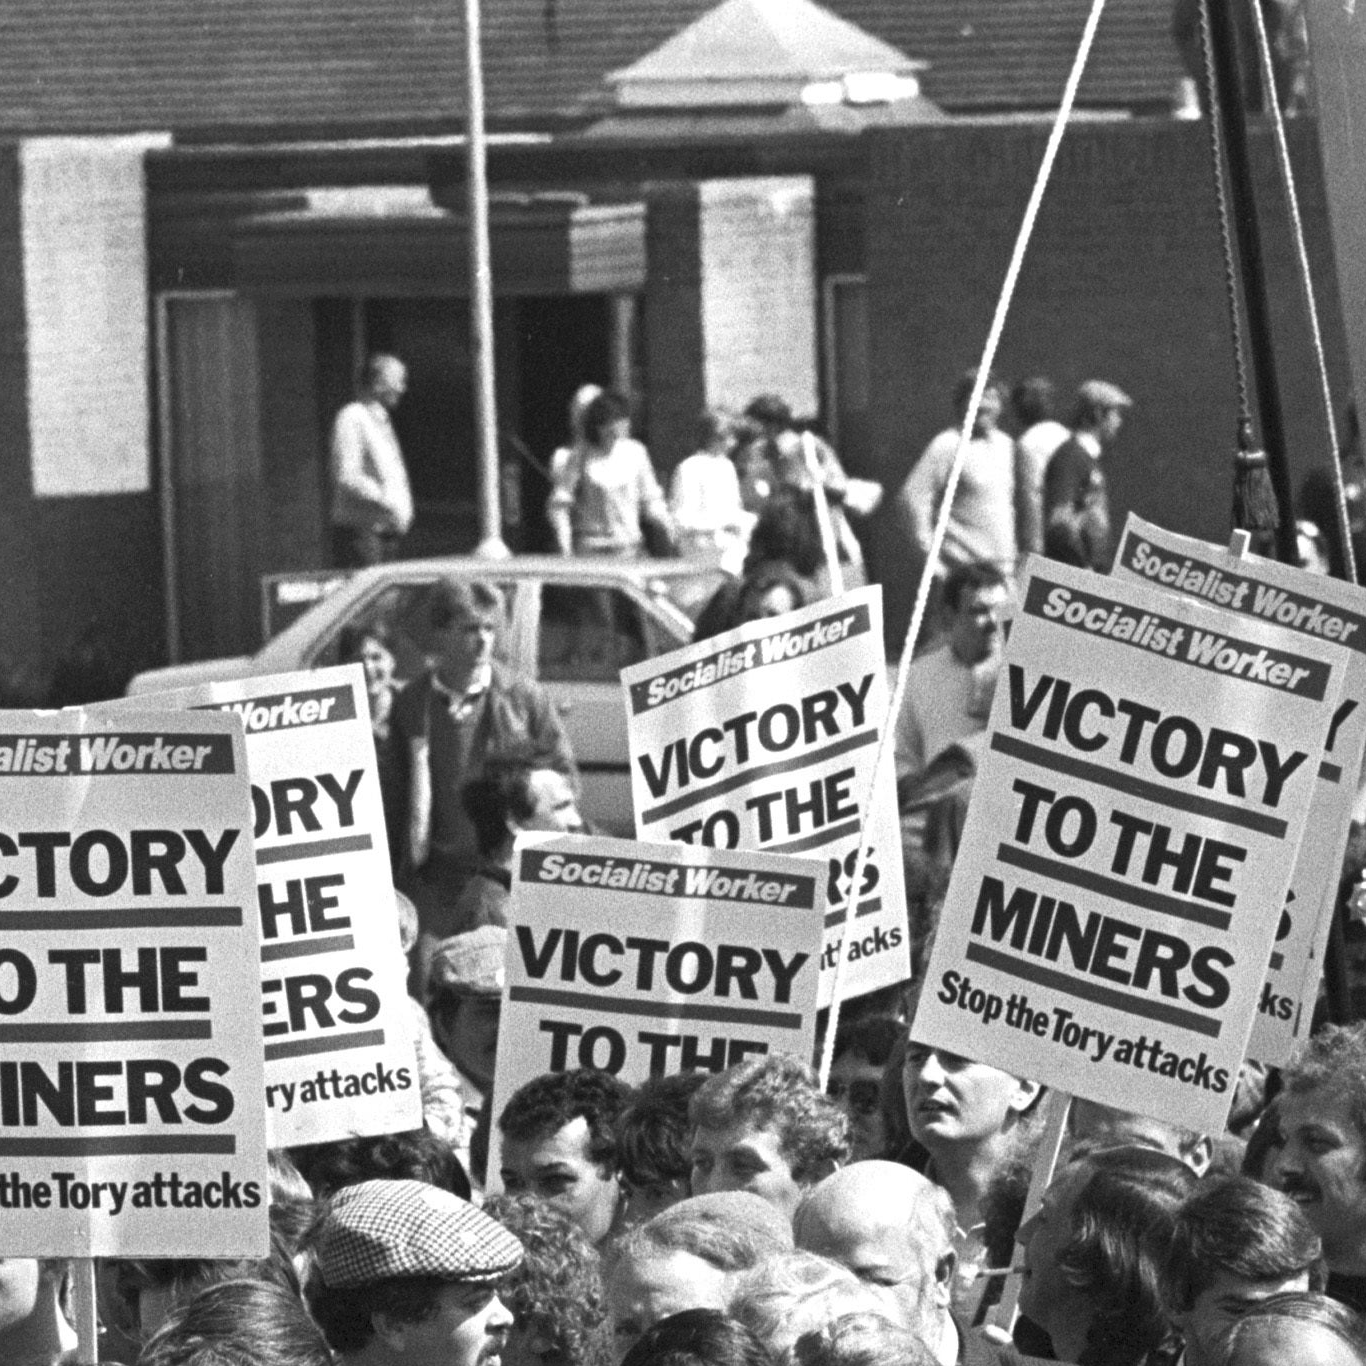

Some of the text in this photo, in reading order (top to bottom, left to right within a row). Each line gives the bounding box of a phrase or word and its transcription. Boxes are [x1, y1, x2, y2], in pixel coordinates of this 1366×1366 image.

[1132, 543, 1358, 641] Socialist Worker
[648, 616, 854, 705] Socialist Worker
[1043, 588, 1309, 688] Socialist Worker
[80, 739, 211, 775] Worker
[638, 674, 874, 798] VICTORY
[1009, 664, 1308, 807] VICTORY
[670, 767, 859, 849] TO THE
[1013, 778, 1247, 907] TO THE
[258, 874, 351, 939] HE
[539, 856, 679, 893] Socialist
[685, 868, 796, 902] Worker
[48, 947, 210, 1014] THE
[516, 925, 809, 1003] VICTORY
[971, 876, 1235, 1008] MINERS
[261, 968, 380, 1036] ERS
[938, 971, 1228, 1093] Stop the Tory attacks
[266, 1064, 411, 1112] ry attacks
[539, 1020, 627, 1077] TO
[51, 1172, 127, 1215] Tory
[132, 1172, 260, 1208] attacks
